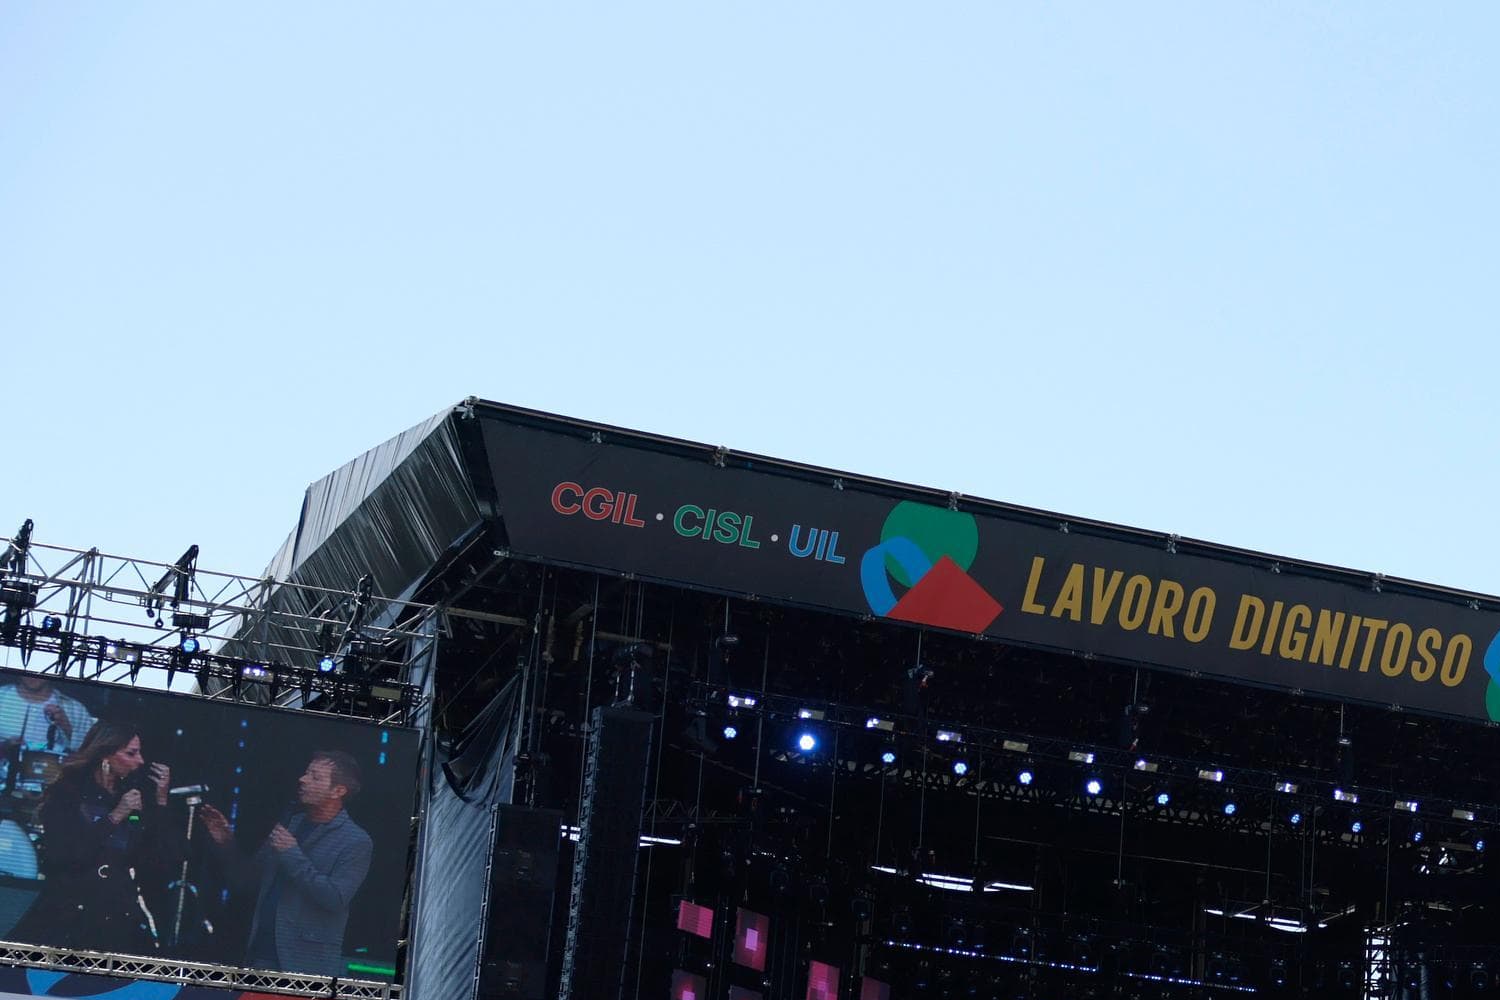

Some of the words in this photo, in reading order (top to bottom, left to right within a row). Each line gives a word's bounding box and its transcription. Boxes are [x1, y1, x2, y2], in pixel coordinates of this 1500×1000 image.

[551, 481, 645, 528] CGIL
[673, 504, 760, 549] CISL
[788, 524, 846, 564] UIL
[1020, 556, 1217, 643] LAVORO
[1229, 593, 1473, 688] DIGNITOSO
